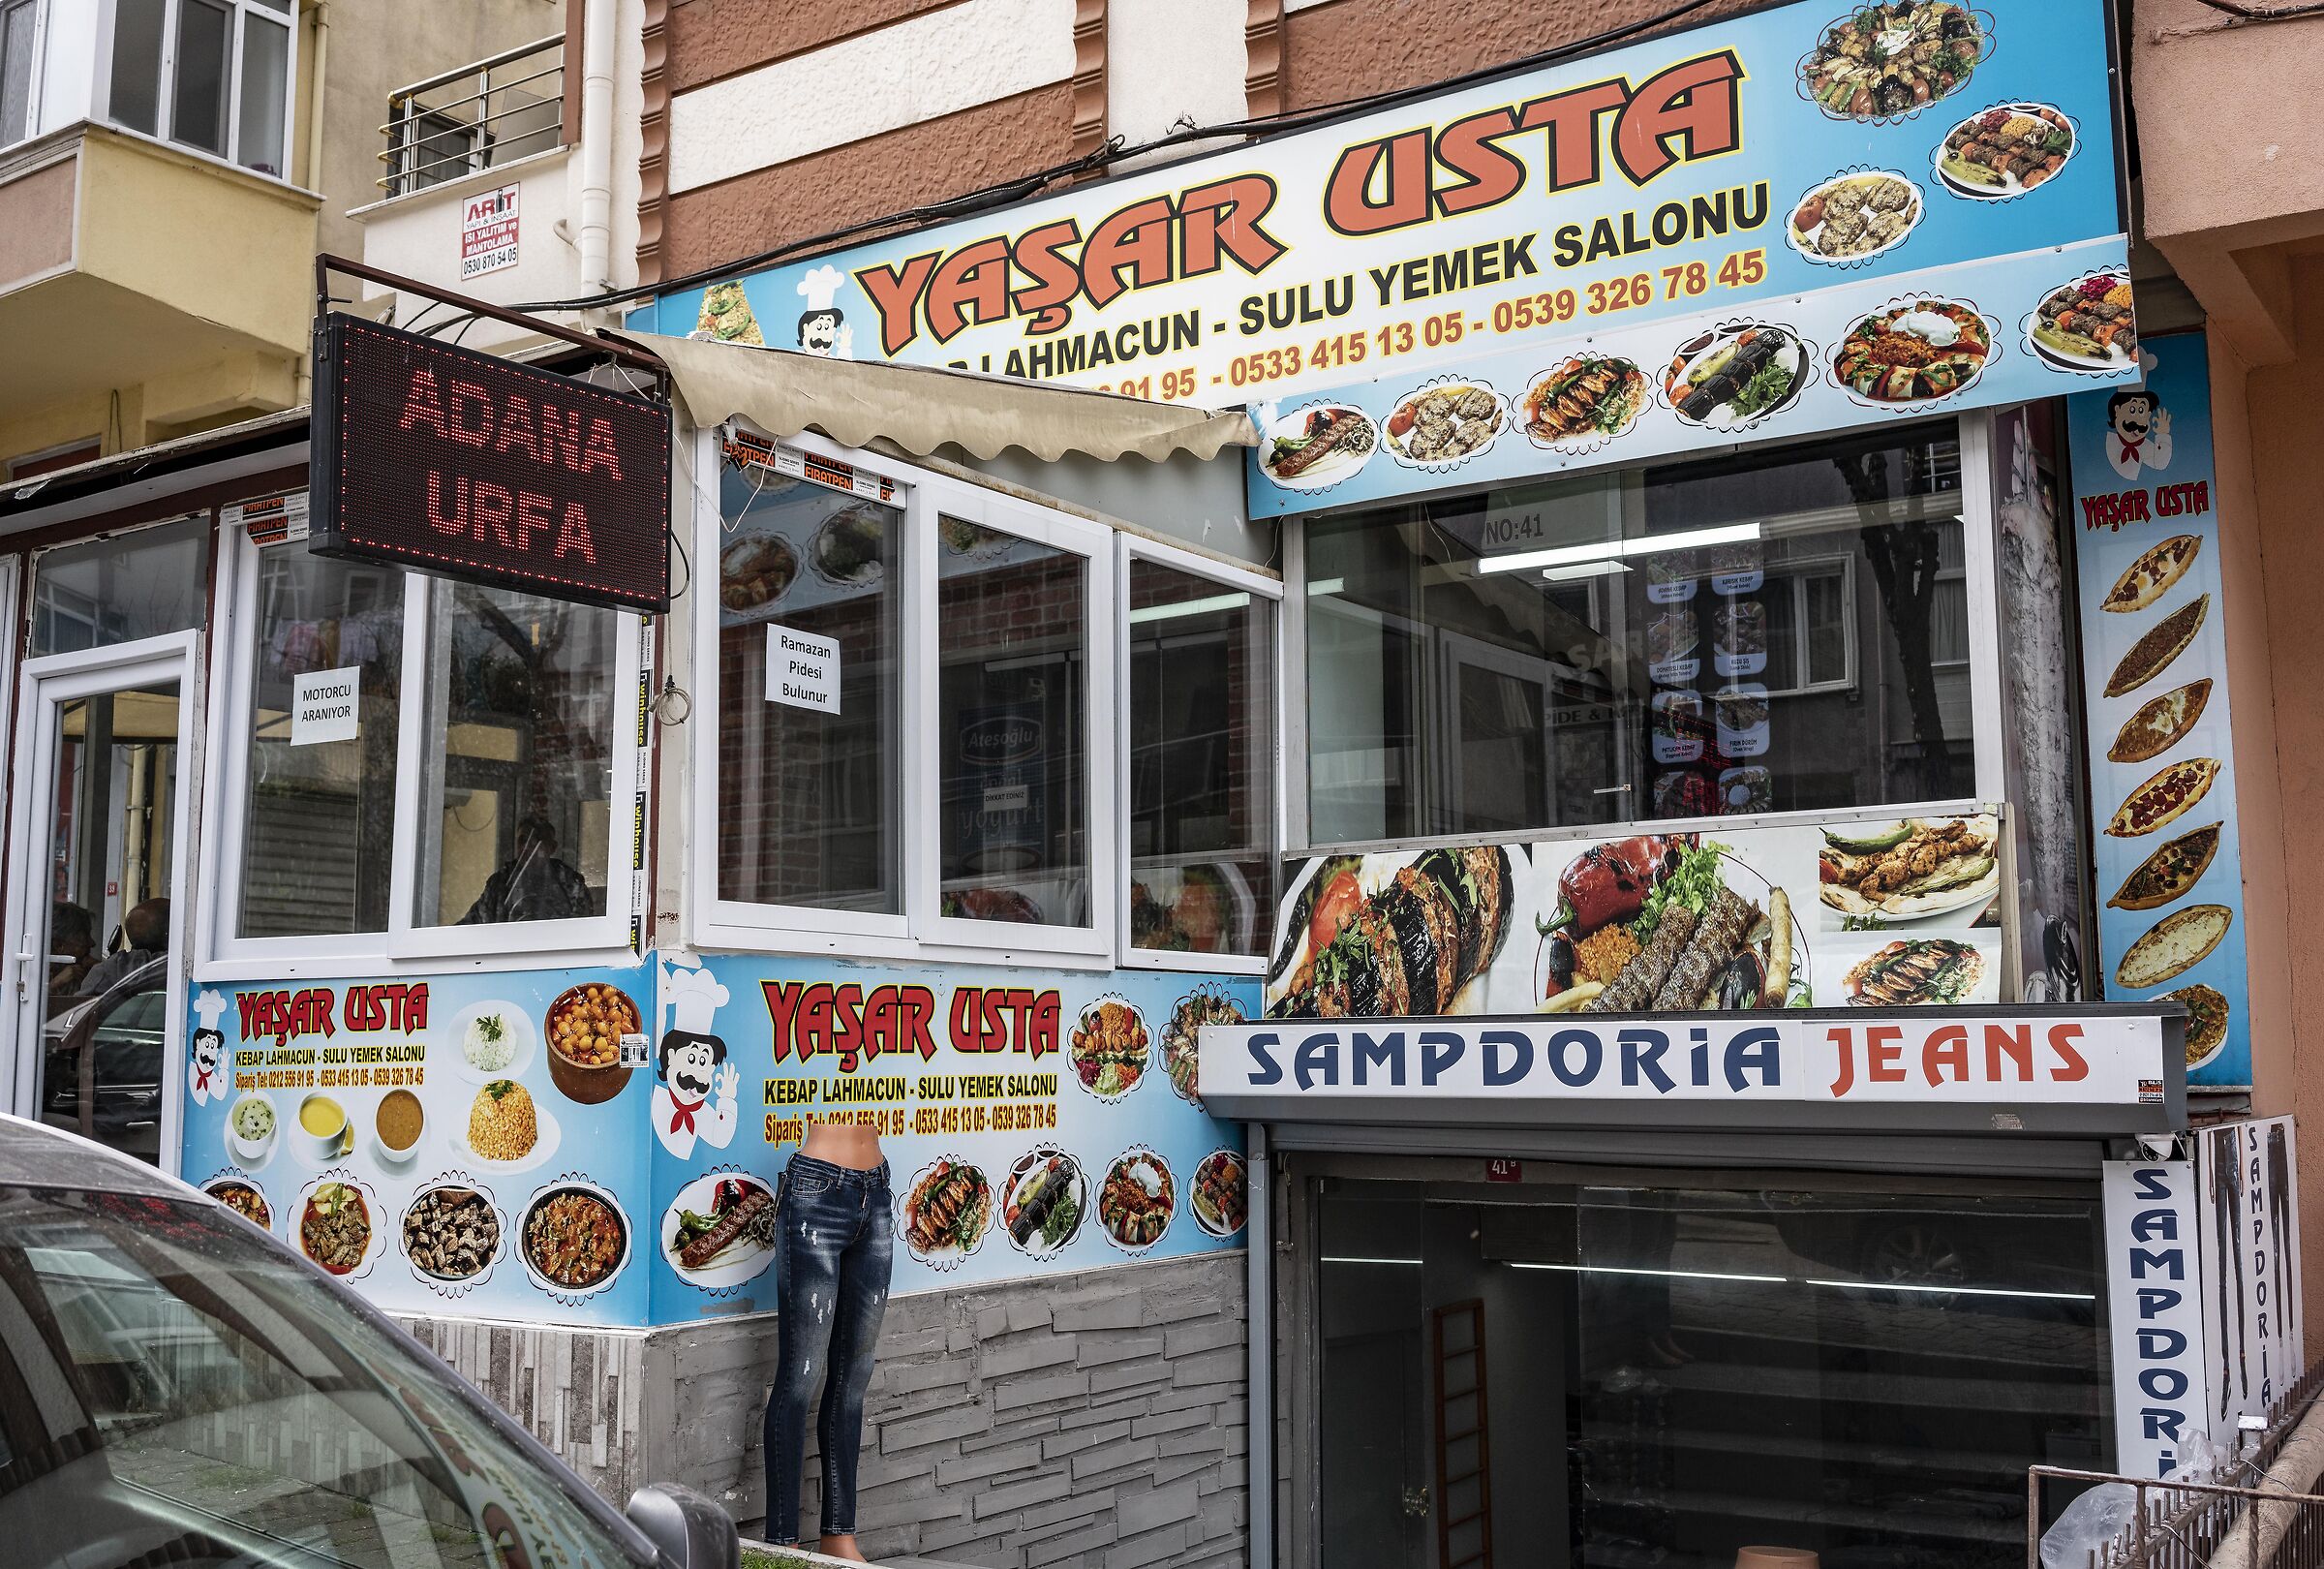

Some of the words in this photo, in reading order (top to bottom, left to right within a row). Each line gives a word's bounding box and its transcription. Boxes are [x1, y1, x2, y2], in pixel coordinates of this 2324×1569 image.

[854, 174, 1289, 357] YAŞAR
[1324, 48, 1746, 236] USTA
[467, 233, 513, 256] MANTOLAMA
[477, 223, 506, 239] YALITIM
[508, 222, 517, 231] ve
[464, 258, 480, 274] 0530
[482, 253, 496, 269] 870
[498, 251, 505, 264] 54
[508, 247, 517, 262] 05
[1239, 275, 1354, 335] SULU
[1369, 234, 1538, 306] YEMEK
[1553, 183, 1769, 268] SALONU
[1162, 367, 1196, 400] 95
[1230, 346, 1301, 387] 0533
[1310, 332, 1366, 371] 415
[1377, 321, 1414, 355] 13
[1423, 312, 1463, 349] 05
[1494, 289, 1575, 334] 0539
[1588, 273, 1651, 316] 326
[1663, 262, 1706, 301] 78
[1719, 251, 1765, 291] 45
[400, 369, 624, 481] ADANA
[805, 466, 852, 491] FIRATPEN
[427, 470, 596, 565] URFA
[2081, 489, 2152, 532] YAŞAR
[2156, 480, 2210, 516] USTA
[1485, 513, 1544, 544] NO:41
[780, 635, 831, 659] Ramazan
[789, 661, 822, 680] Pidesi
[302, 684, 352, 702] MOTORCU
[782, 683, 828, 704] Bulunur
[301, 705, 352, 723] ARANIYOR
[236, 987, 336, 1047] YAŞAR
[344, 982, 430, 1036] USTA
[760, 980, 937, 1073] YAŞAR
[949, 986, 1061, 1061] USTA
[235, 1051, 263, 1066] KEBAP
[266, 1049, 316, 1065] LAHMACUN
[322, 1048, 348, 1064] SULU
[351, 1047, 383, 1062] YEMEK
[386, 1045, 425, 1061] SALONU
[1826, 1022, 2090, 1098] JEANS
[235, 1071, 256, 1092] Sipariş
[257, 1071, 267, 1088] Tel:
[268, 1070, 284, 1088] 0212
[285, 1070, 296, 1087] 556
[297, 1069, 305, 1086] 91
[306, 1069, 314, 1086] 95
[321, 1068, 336, 1087] 0533
[337, 1068, 350, 1086] 415
[351, 1068, 359, 1086] 13
[360, 1068, 369, 1086] 05
[374, 1067, 389, 1086] 0539
[391, 1067, 404, 1085] 326
[406, 1067, 413, 1085] 78
[414, 1066, 424, 1085] 45
[764, 1079, 818, 1104] KEBAP
[822, 1077, 906, 1102] LAHMACUN
[918, 1076, 954, 1099] SULU
[959, 1075, 1004, 1098] YEMEK
[1007, 1074, 1057, 1096] SALONU
[765, 1114, 803, 1148] Sipariş
[877, 1110, 889, 1136] 91
[892, 1109, 904, 1136] 95
[915, 1108, 938, 1134] 0533
[940, 1107, 958, 1132] 415
[961, 1106, 971, 1131] 13
[973, 1106, 985, 1131] 05
[993, 1105, 1013, 1130] 0539
[1016, 1104, 1031, 1129] 326
[1033, 1103, 1044, 1128] 78
[1045, 1103, 1056, 1128] 45
[1492, 1159, 1508, 1175] 41
[2129, 1168, 2188, 1481] SAMPDORİ
